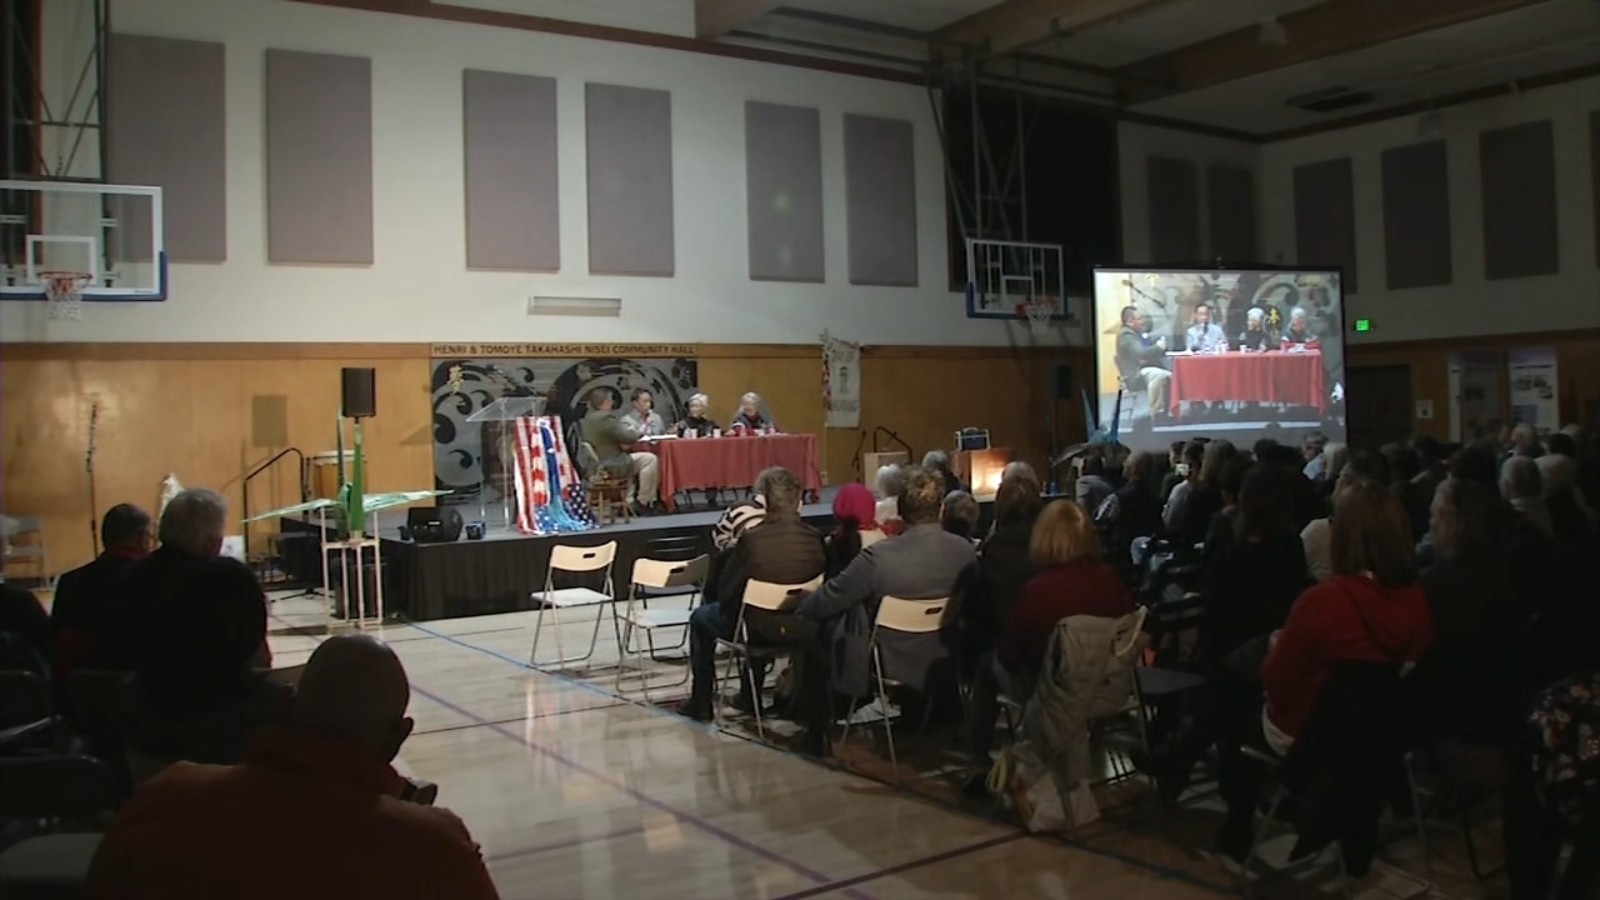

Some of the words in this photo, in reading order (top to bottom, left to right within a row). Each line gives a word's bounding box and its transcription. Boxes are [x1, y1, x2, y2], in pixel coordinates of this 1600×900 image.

[434, 345, 467, 354] HENRI
[469, 345, 478, 354] &
[480, 345, 523, 354] TOMOYE
[526, 345, 582, 354] TAKAHASHI
[585, 345, 610, 354] NISEI
[613, 345, 669, 354] COMMUNITY
[671, 345, 694, 354] HALL
